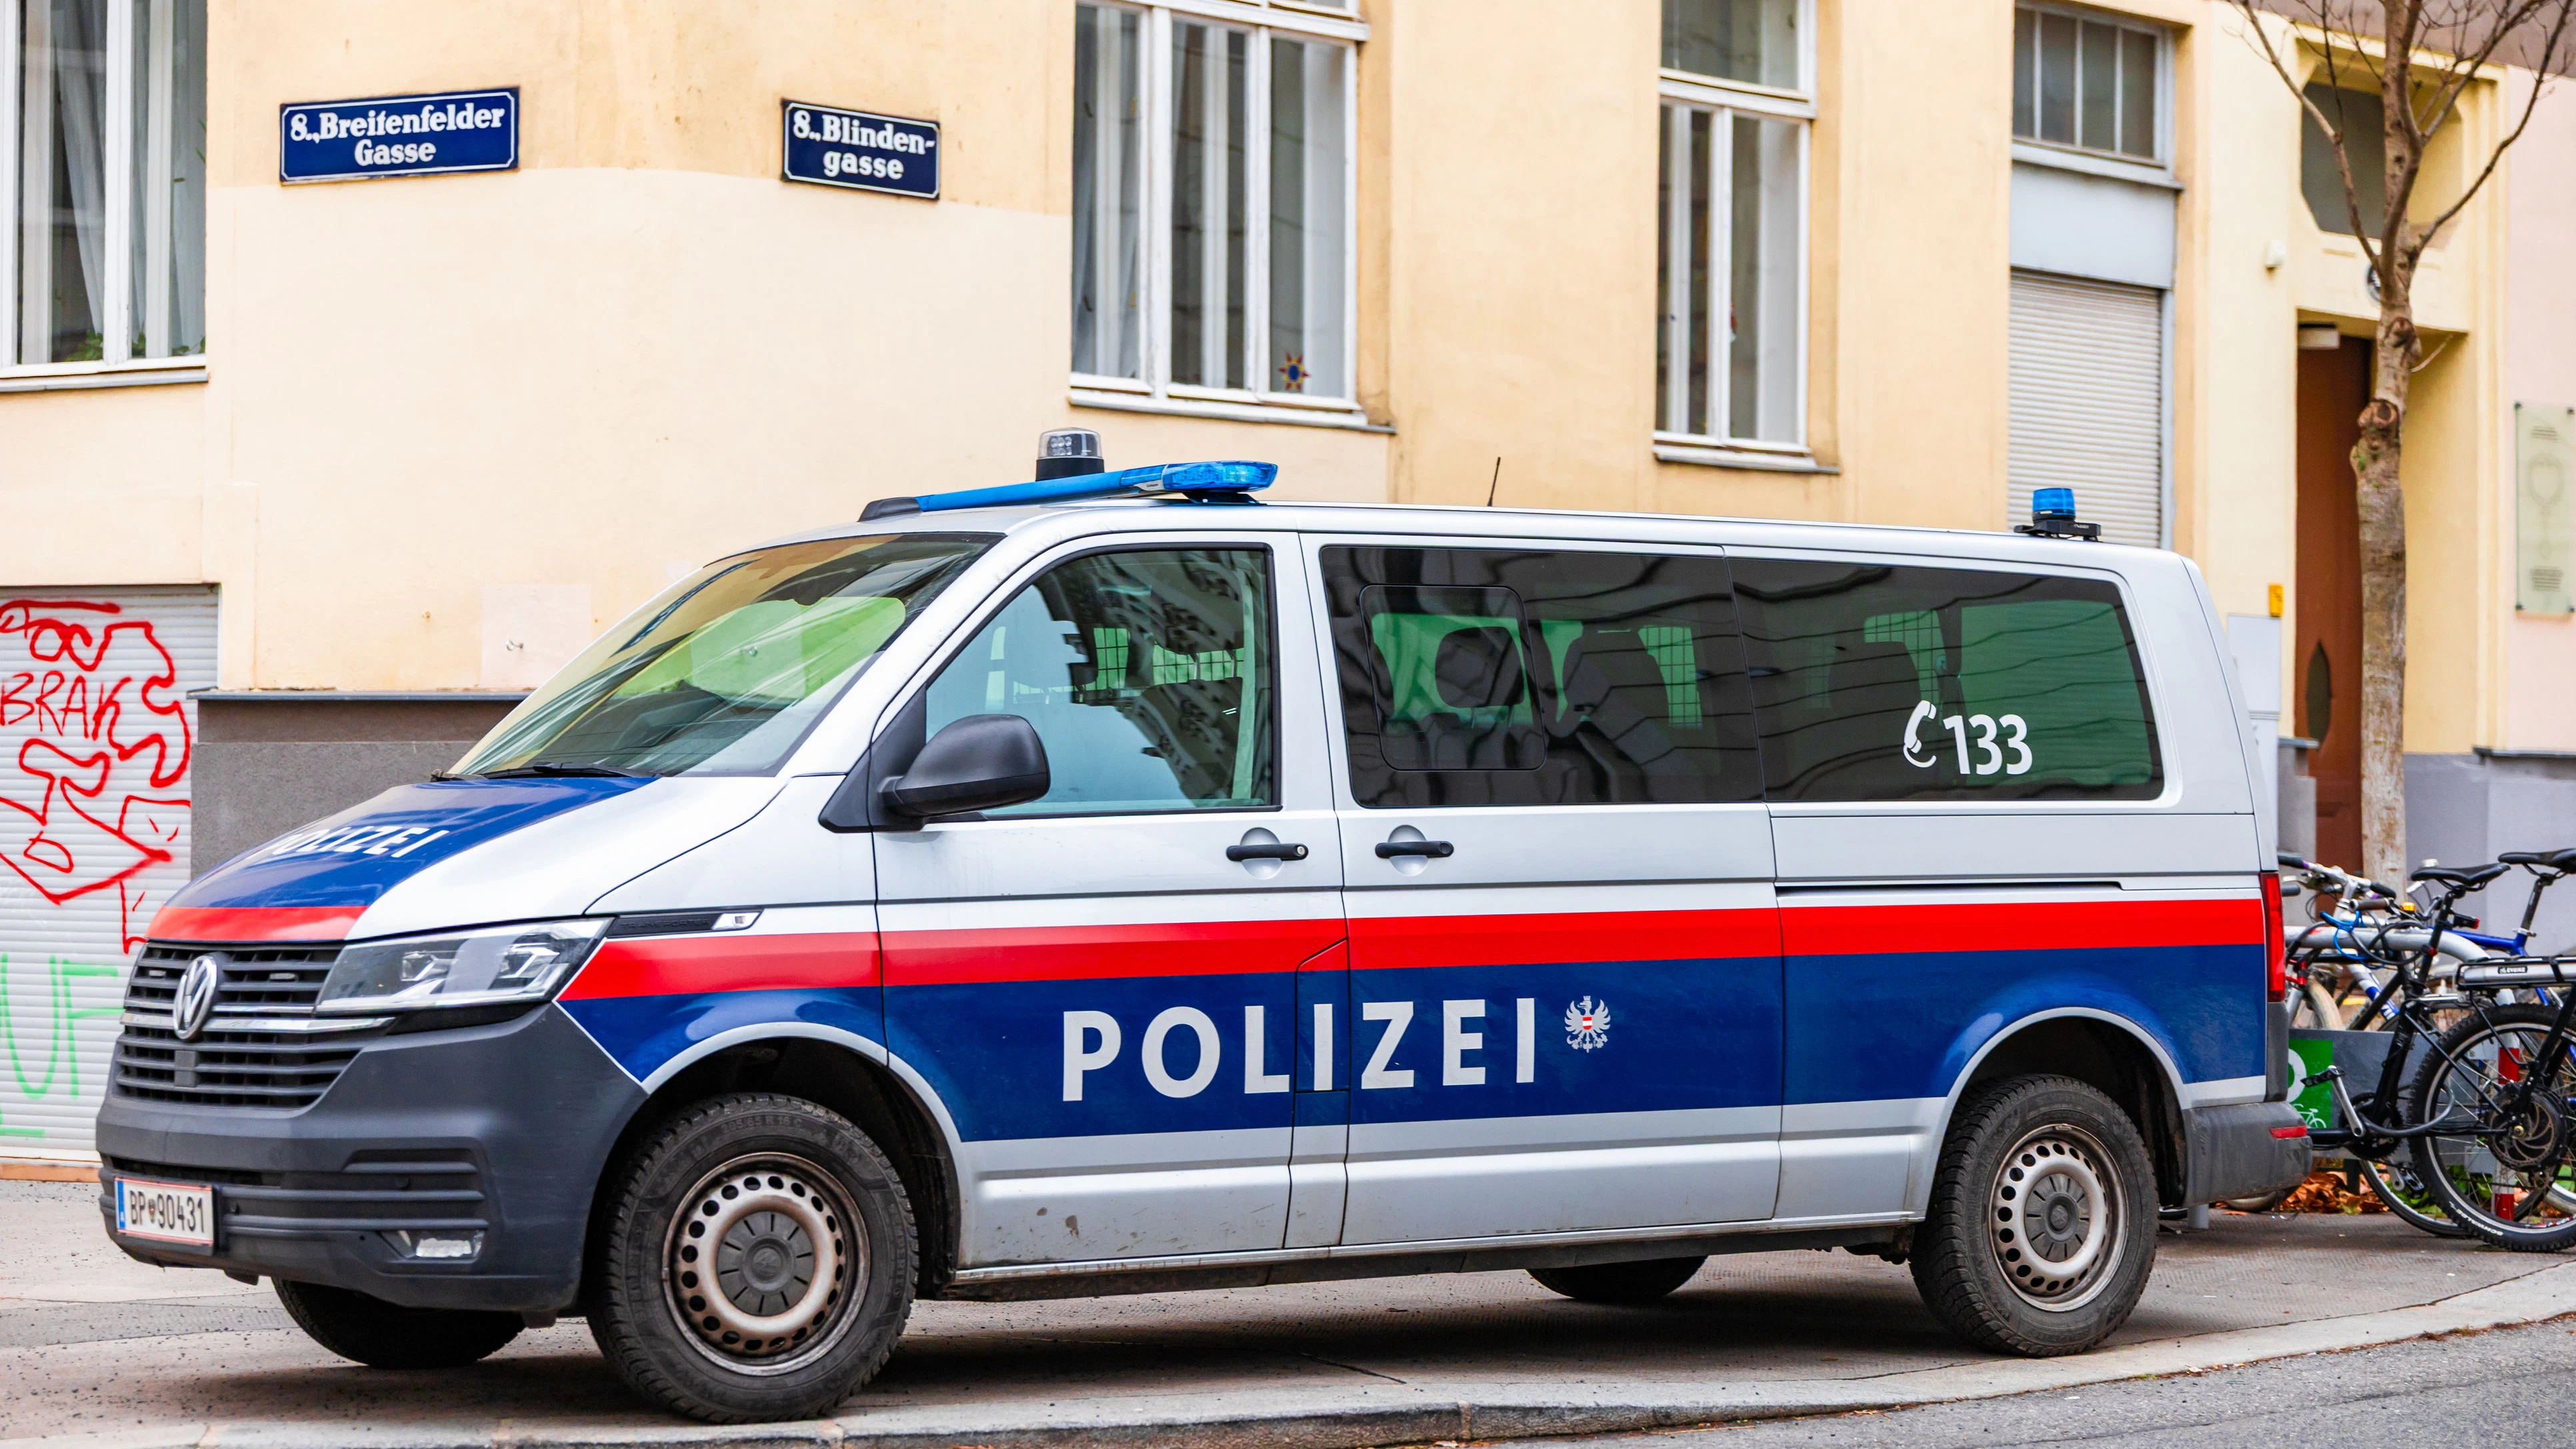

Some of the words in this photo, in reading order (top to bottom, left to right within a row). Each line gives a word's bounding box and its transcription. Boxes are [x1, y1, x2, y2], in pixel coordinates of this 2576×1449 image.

[354, 139, 437, 166] Gasse
[823, 151, 905, 180] gasse
[1943, 713, 2033, 776] 133
[1063, 997, 1535, 1101] POLIZEI
